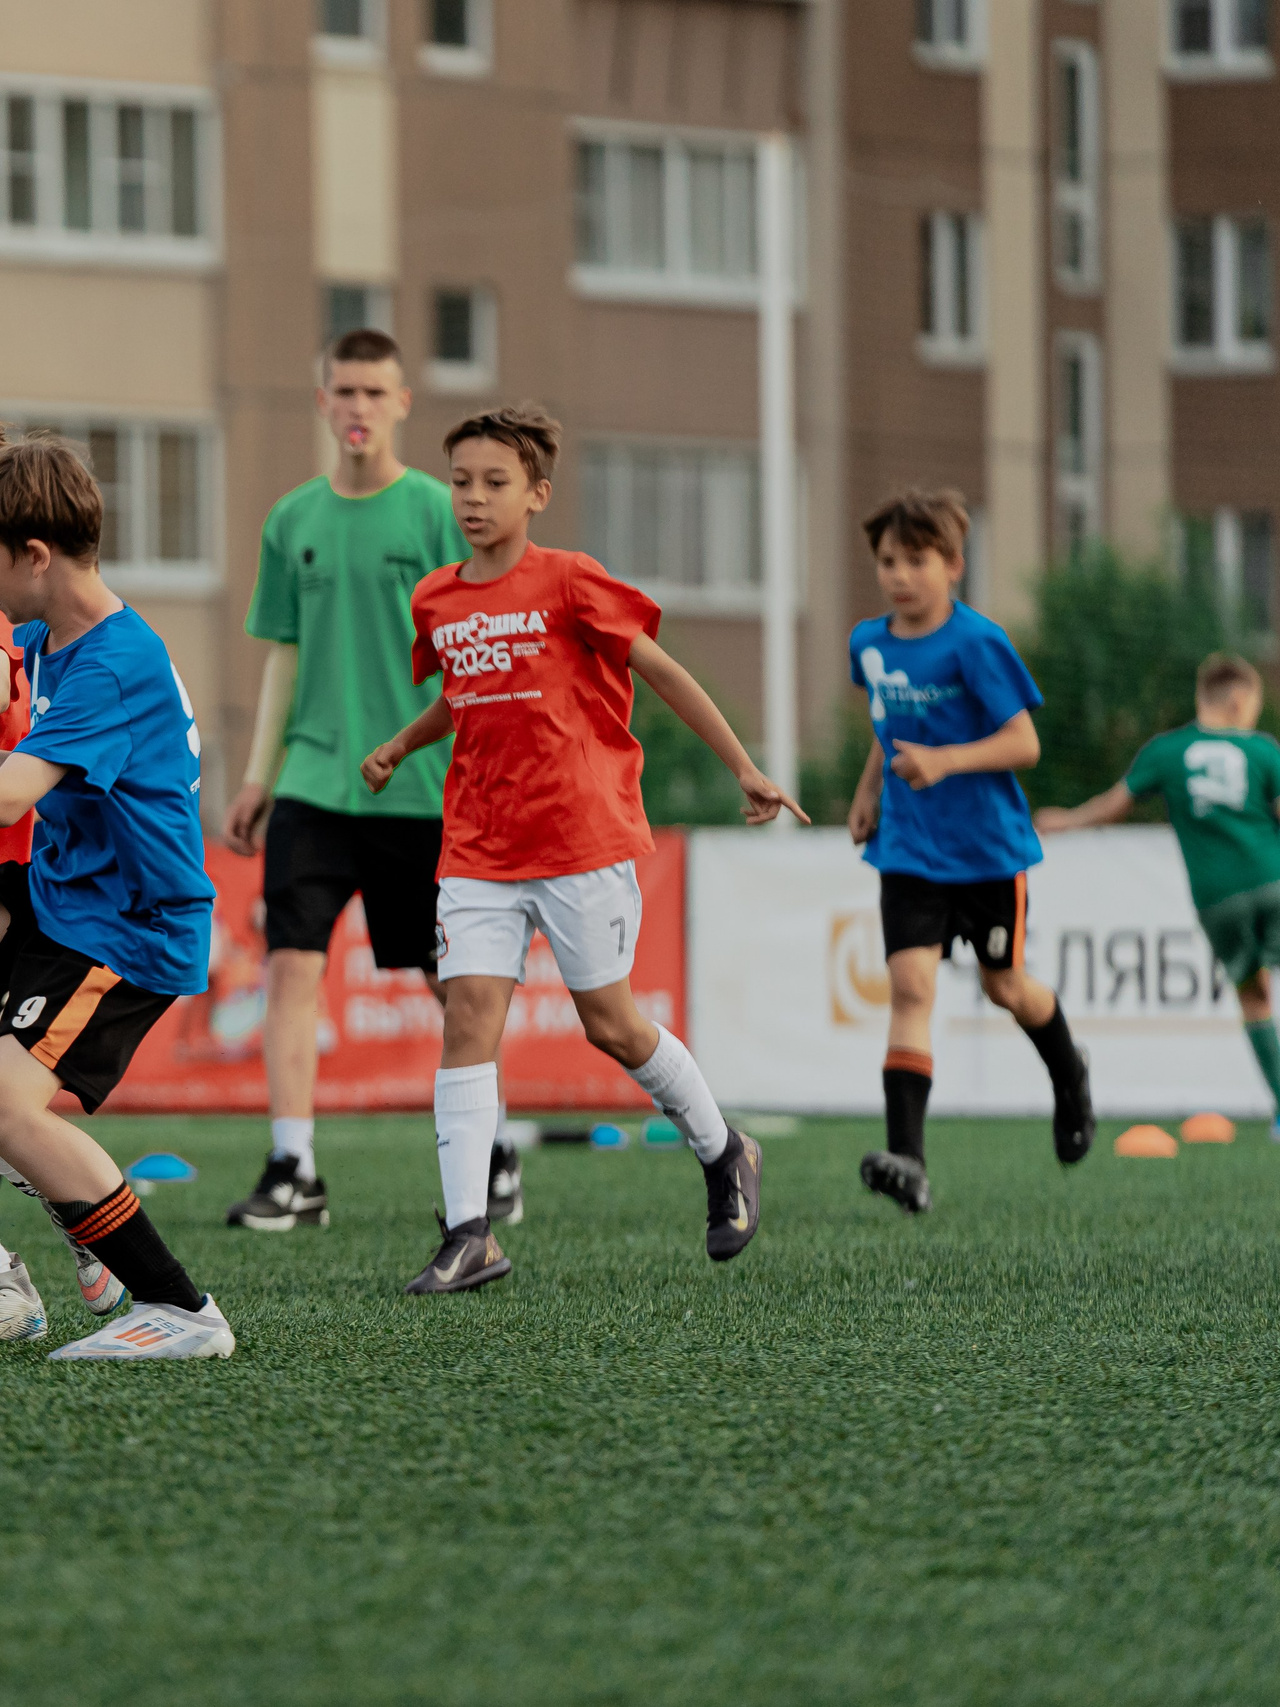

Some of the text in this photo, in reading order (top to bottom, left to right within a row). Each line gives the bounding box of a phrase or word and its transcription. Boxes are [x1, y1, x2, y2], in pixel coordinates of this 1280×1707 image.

[445, 641, 512, 677] 2026
[609, 915, 626, 957] 7
[11, 995, 47, 1029] 9
